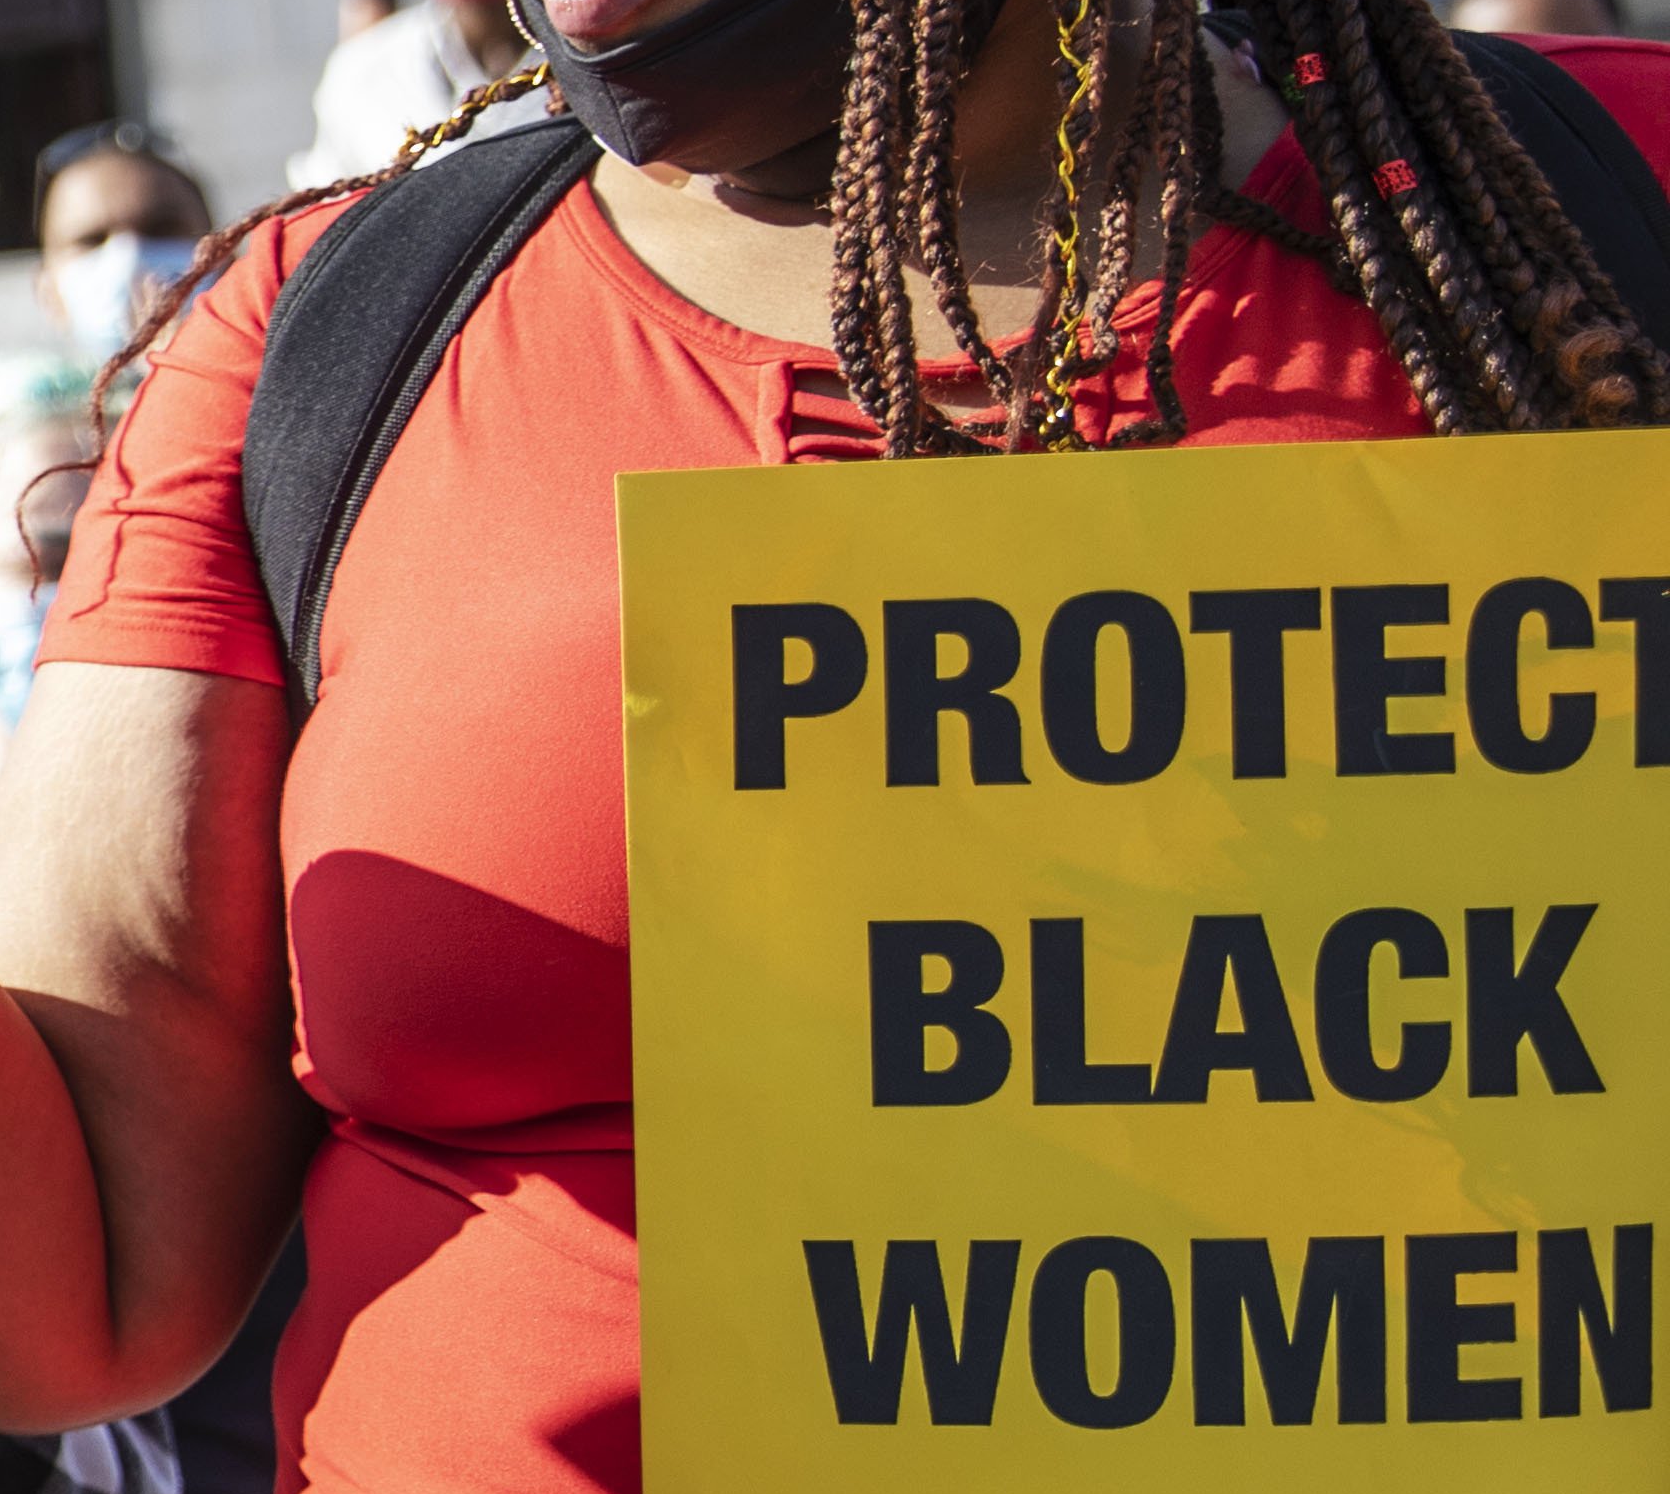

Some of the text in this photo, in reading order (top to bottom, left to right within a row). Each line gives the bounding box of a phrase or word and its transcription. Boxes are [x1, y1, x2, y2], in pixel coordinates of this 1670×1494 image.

[732, 575, 1670, 790] PROTECT
[868, 902, 1607, 1107] BLACK
[802, 1223, 1654, 1430] WOMEN
